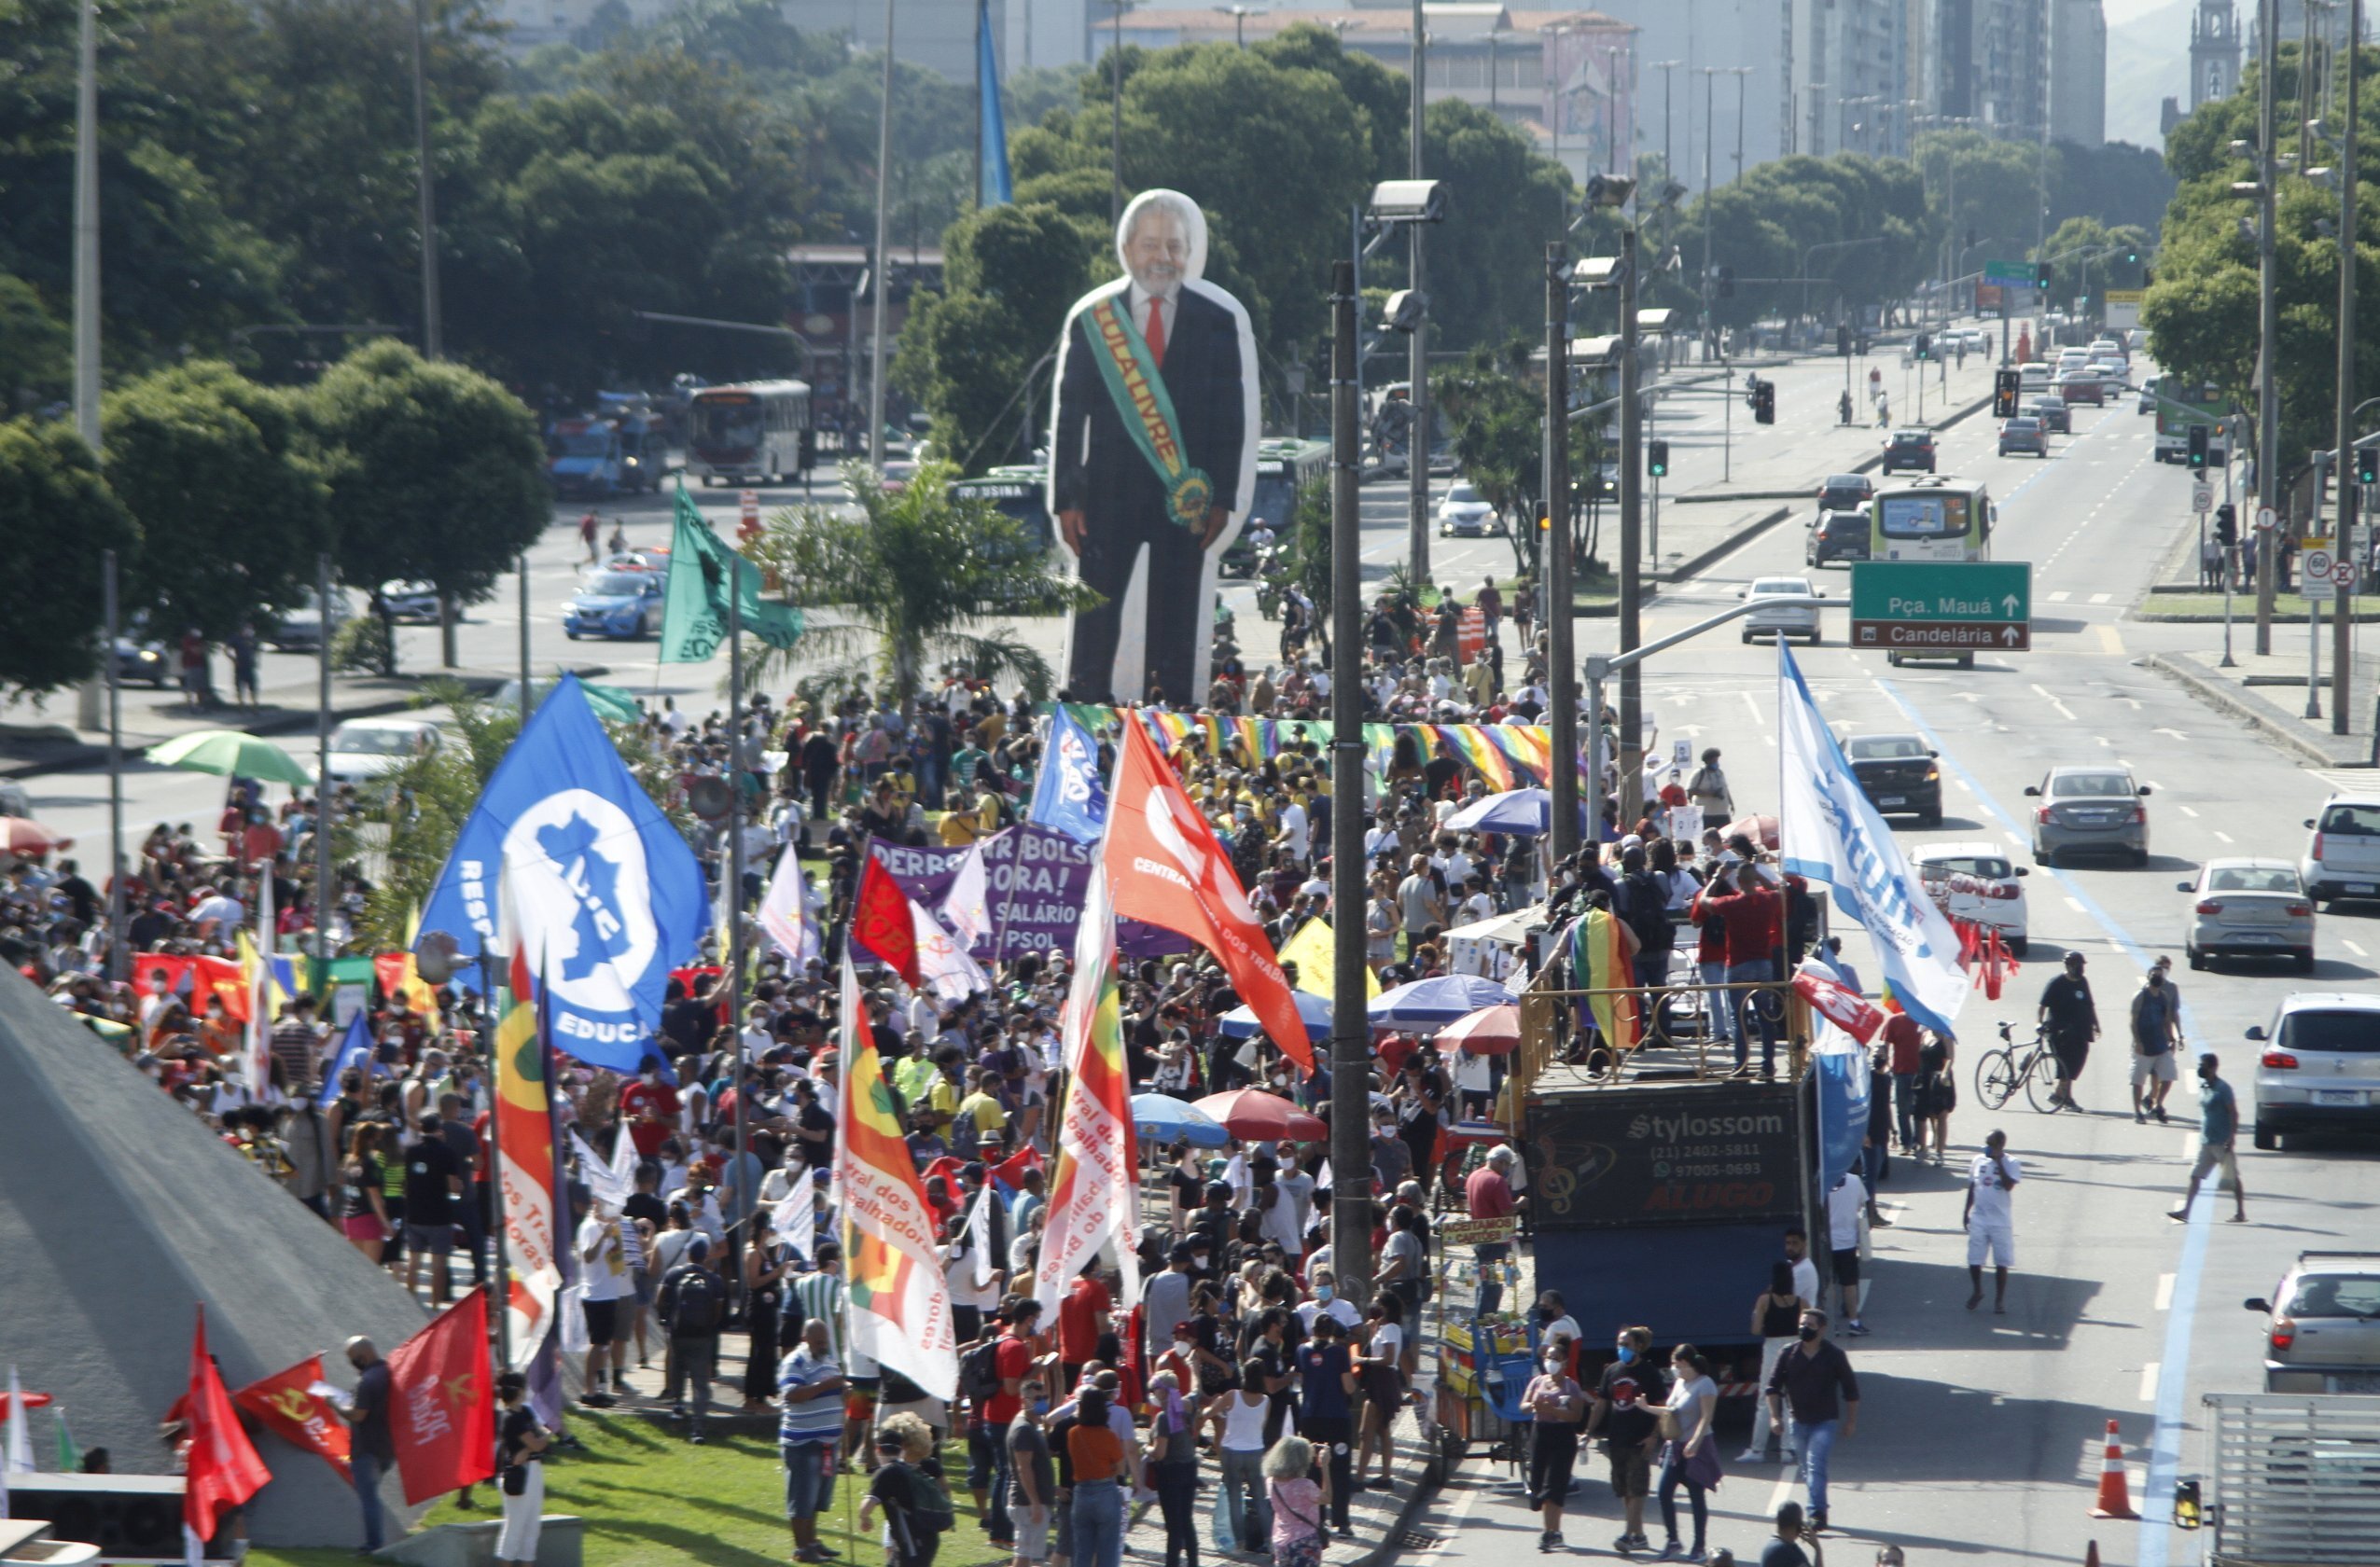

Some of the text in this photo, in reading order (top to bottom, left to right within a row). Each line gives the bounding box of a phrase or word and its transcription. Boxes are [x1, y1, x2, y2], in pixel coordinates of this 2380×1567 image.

[1092, 303, 1181, 464] LULA LIVRE
[982, 485, 1023, 497] USINA
[1888, 597, 1993, 617] Pça. Mauá
[1890, 625, 1994, 644] Candelária
[1221, 927, 1250, 955] DOS
[1626, 1112, 1783, 1144] Stylossom
[1649, 1145, 1679, 1162] (21)
[877, 1181, 912, 1213] dos
[1642, 1181, 1775, 1211] ALUGO
